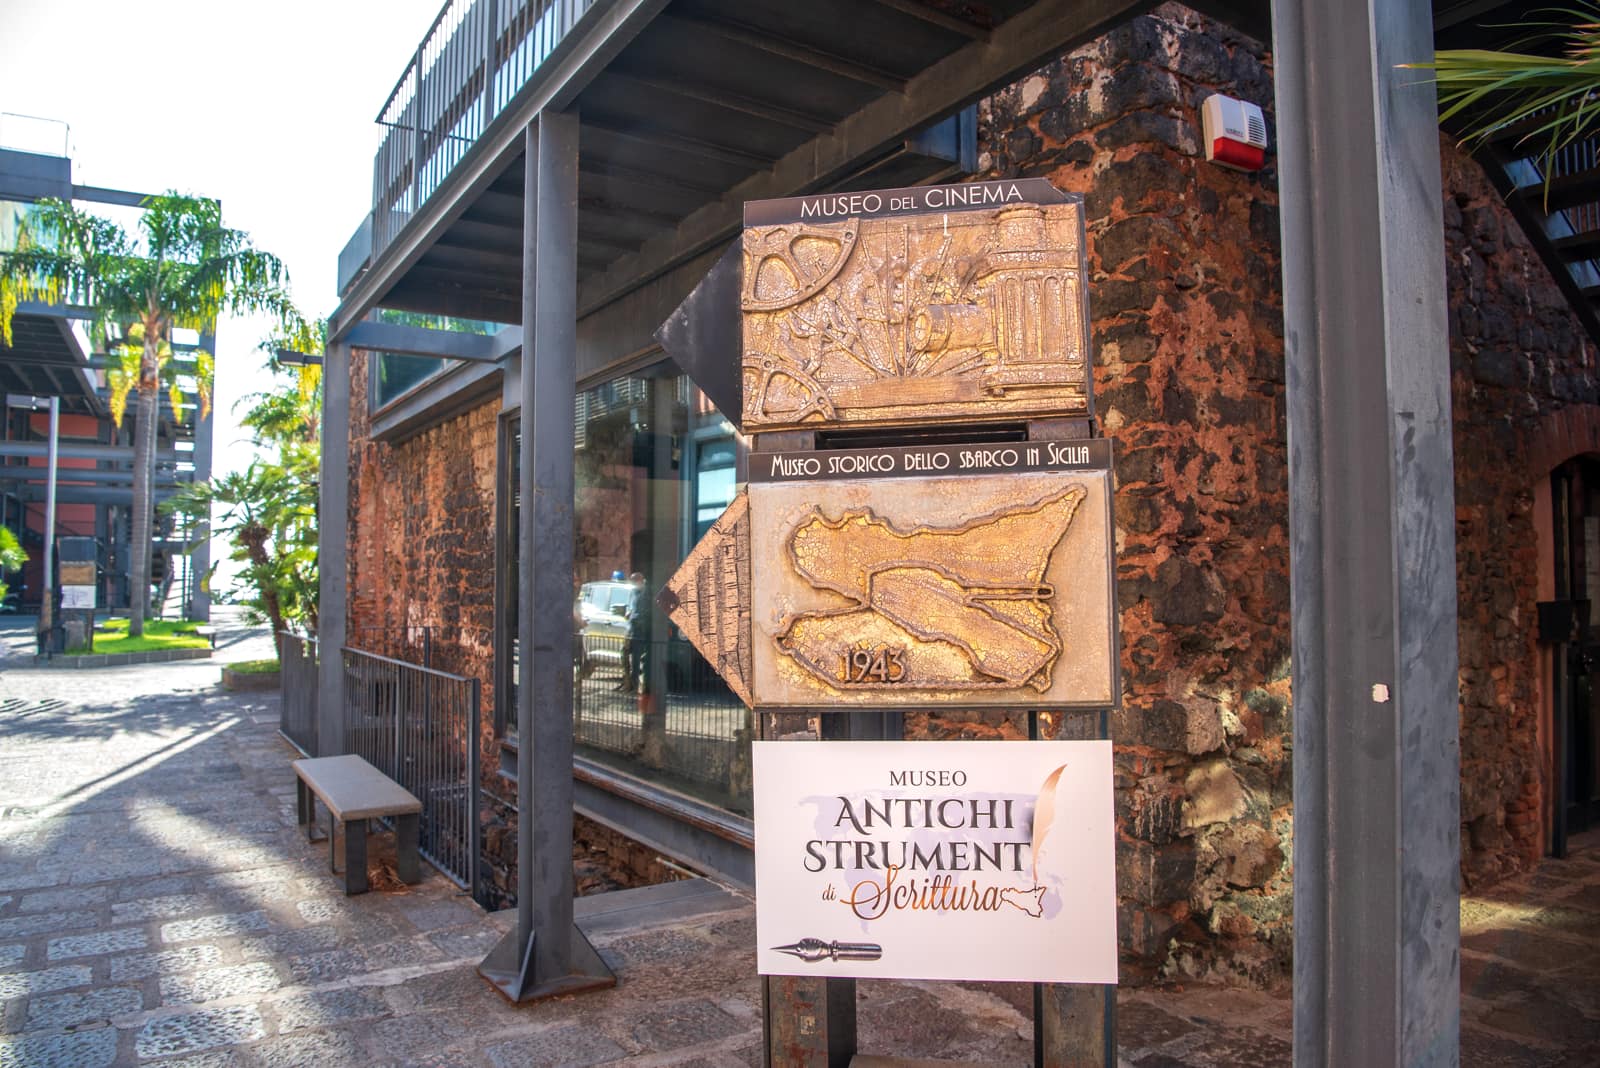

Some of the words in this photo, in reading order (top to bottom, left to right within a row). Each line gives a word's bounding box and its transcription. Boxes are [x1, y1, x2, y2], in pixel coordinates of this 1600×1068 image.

[801, 195, 882, 217] MUSEO
[890, 196, 918, 211] DEL
[925, 184, 1023, 207] CINEMA
[828, 454, 895, 474] STORICO
[904, 452, 950, 470] DELLO
[959, 449, 1018, 468] SBARCO
[844, 650, 906, 682] 1943
[889, 770, 967, 786] MUSEO
[834, 796, 1015, 835] ANTICHI
[822, 883, 837, 901] di
[840, 864, 1003, 920] Scrittura
